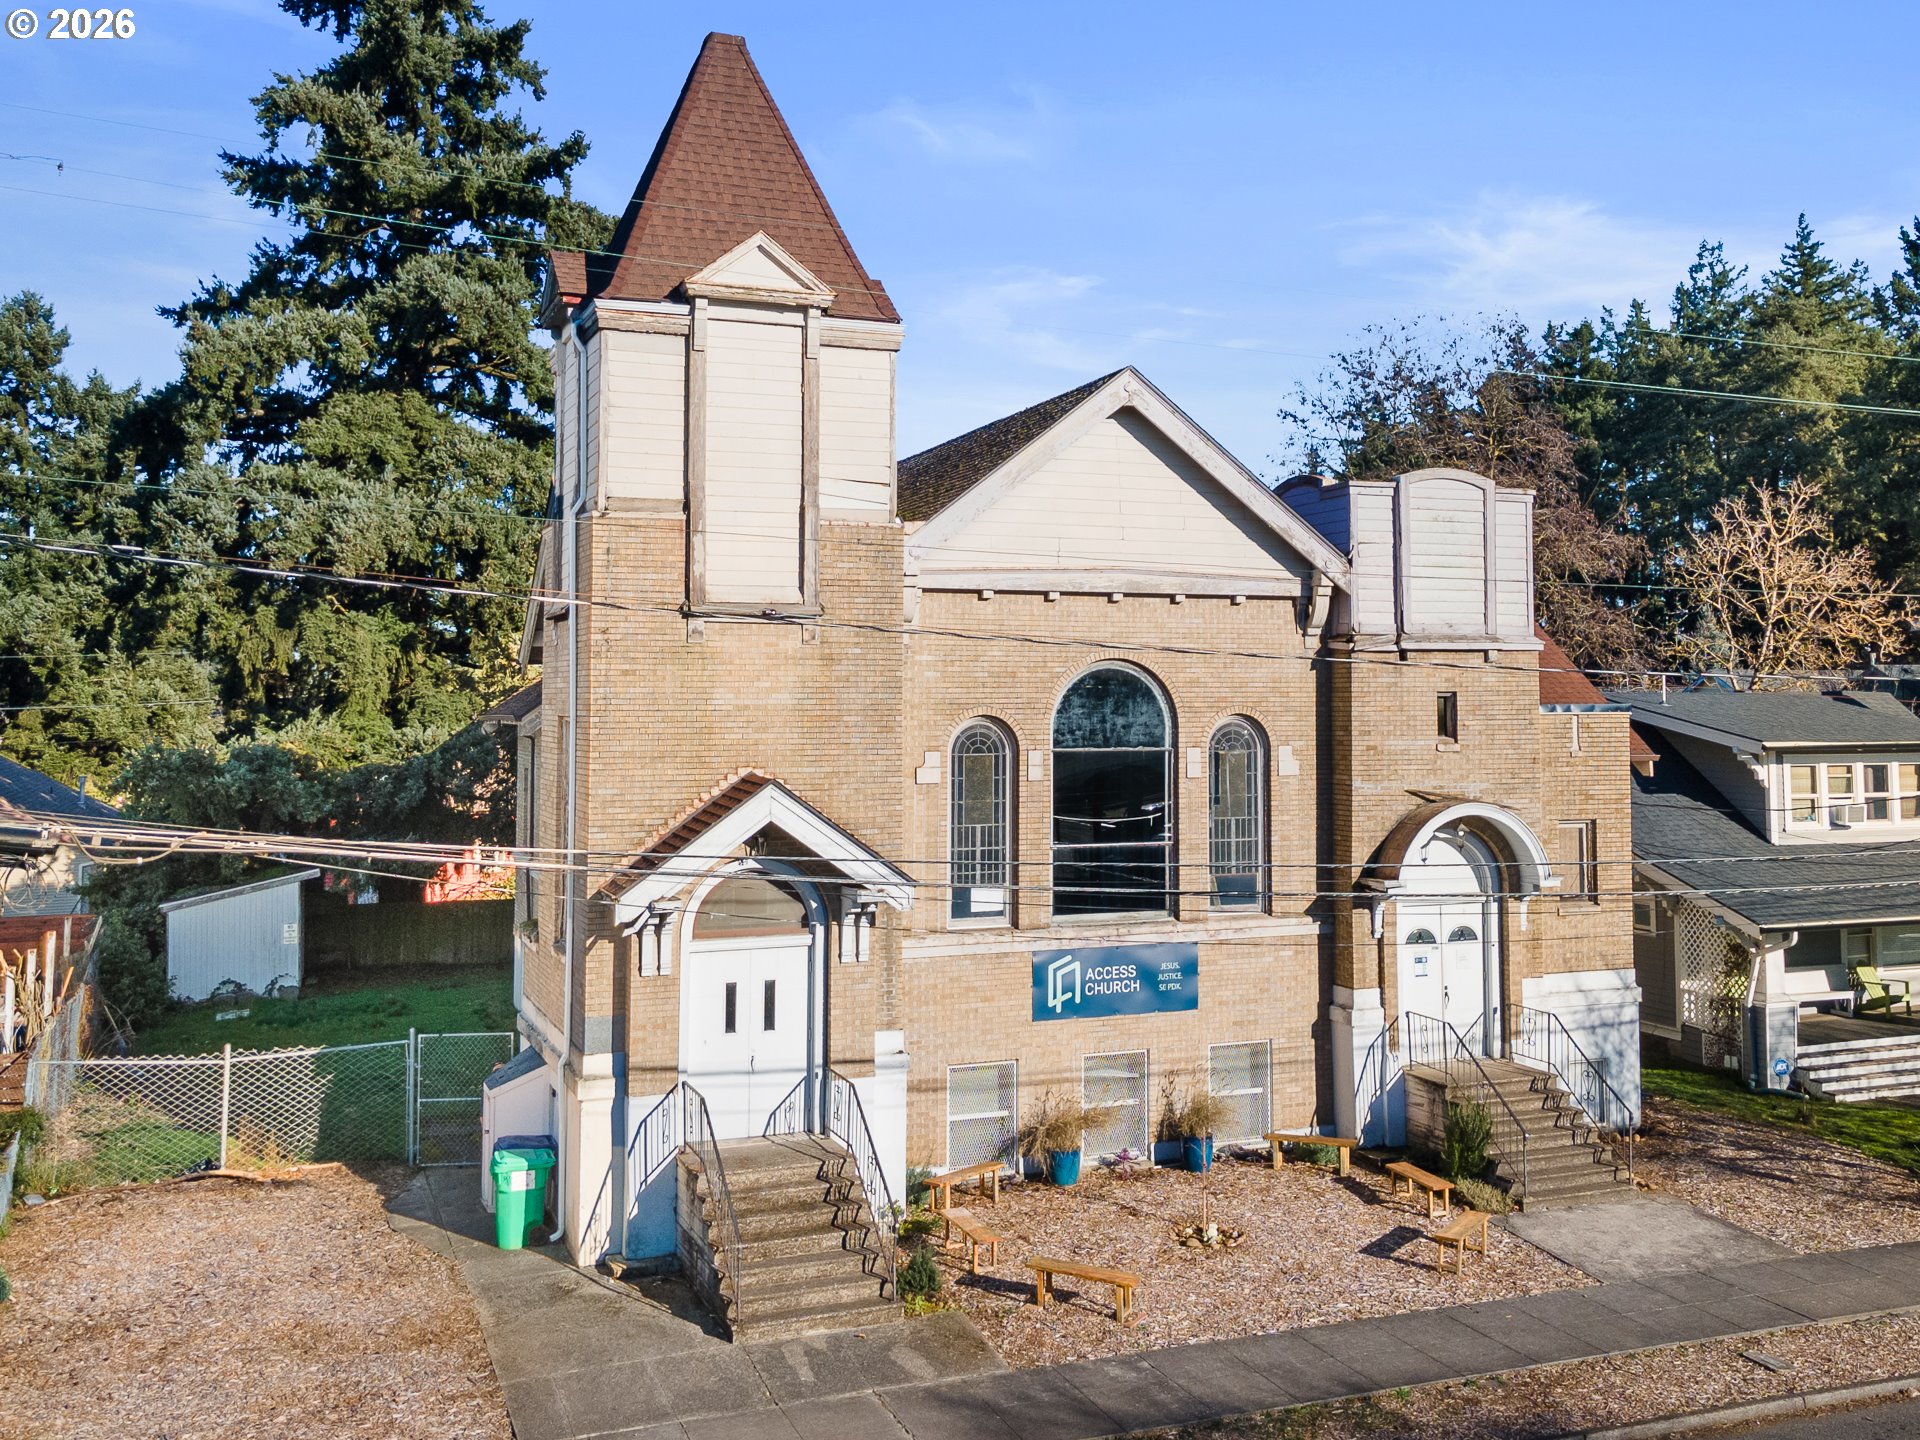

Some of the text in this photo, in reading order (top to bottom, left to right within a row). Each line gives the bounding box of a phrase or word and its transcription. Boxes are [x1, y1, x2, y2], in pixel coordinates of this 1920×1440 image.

[1160, 962, 1180, 970] JESUS.
[1085, 965, 1137, 980] ACCESS
[1157, 972, 1183, 981] JUSTICE.
[1085, 980, 1140, 996] CHURCH
